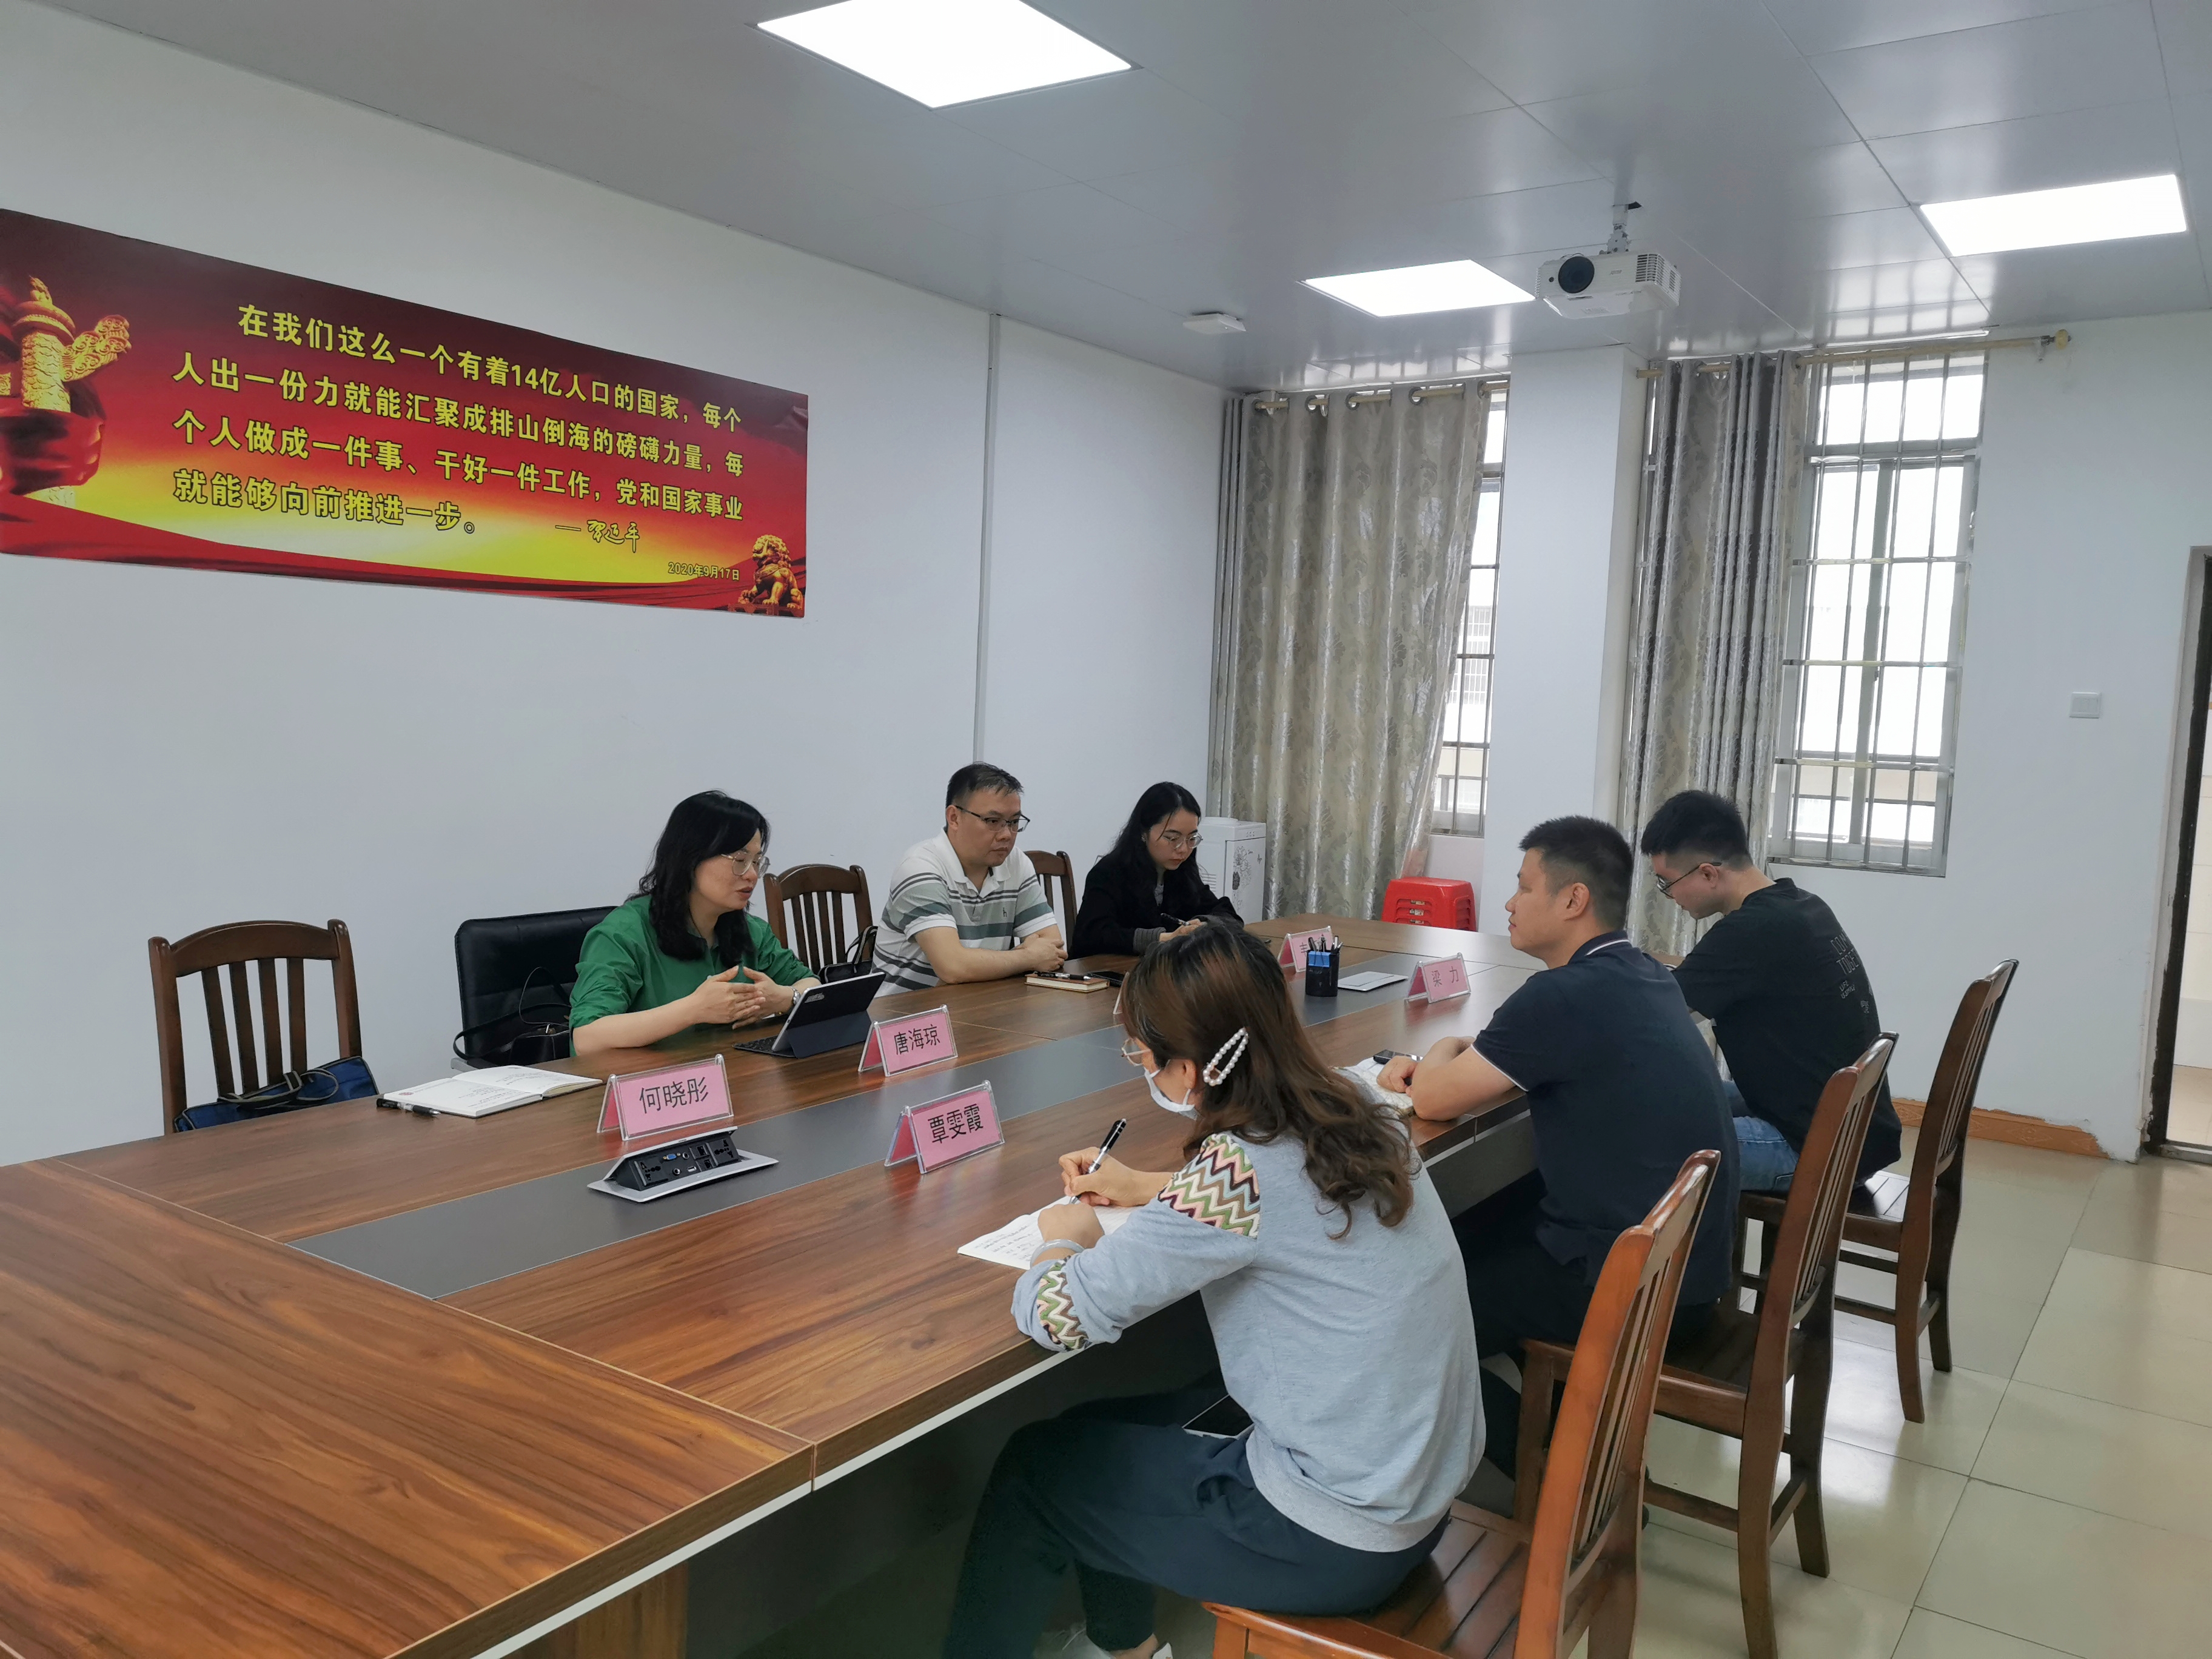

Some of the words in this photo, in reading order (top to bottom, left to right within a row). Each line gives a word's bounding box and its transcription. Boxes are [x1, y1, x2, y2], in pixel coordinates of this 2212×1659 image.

[238, 303, 742, 433] 在我们这么一个有着14亿人口的国家，每个
[172, 352, 744, 478] 人出一份力就能汇聚成排山倒海的磅礴力量，每
[173, 409, 743, 521] 个人做成一件事、干好一件工作，党和国家事业
[173, 468, 475, 535] 就能够向前推进一步。
[668, 561, 740, 581] 2020年9月17日
[894, 1023, 940, 1056] 唐海琼
[638, 1076, 709, 1114] 何晓彤
[927, 1102, 985, 1144] 覃雯霞
